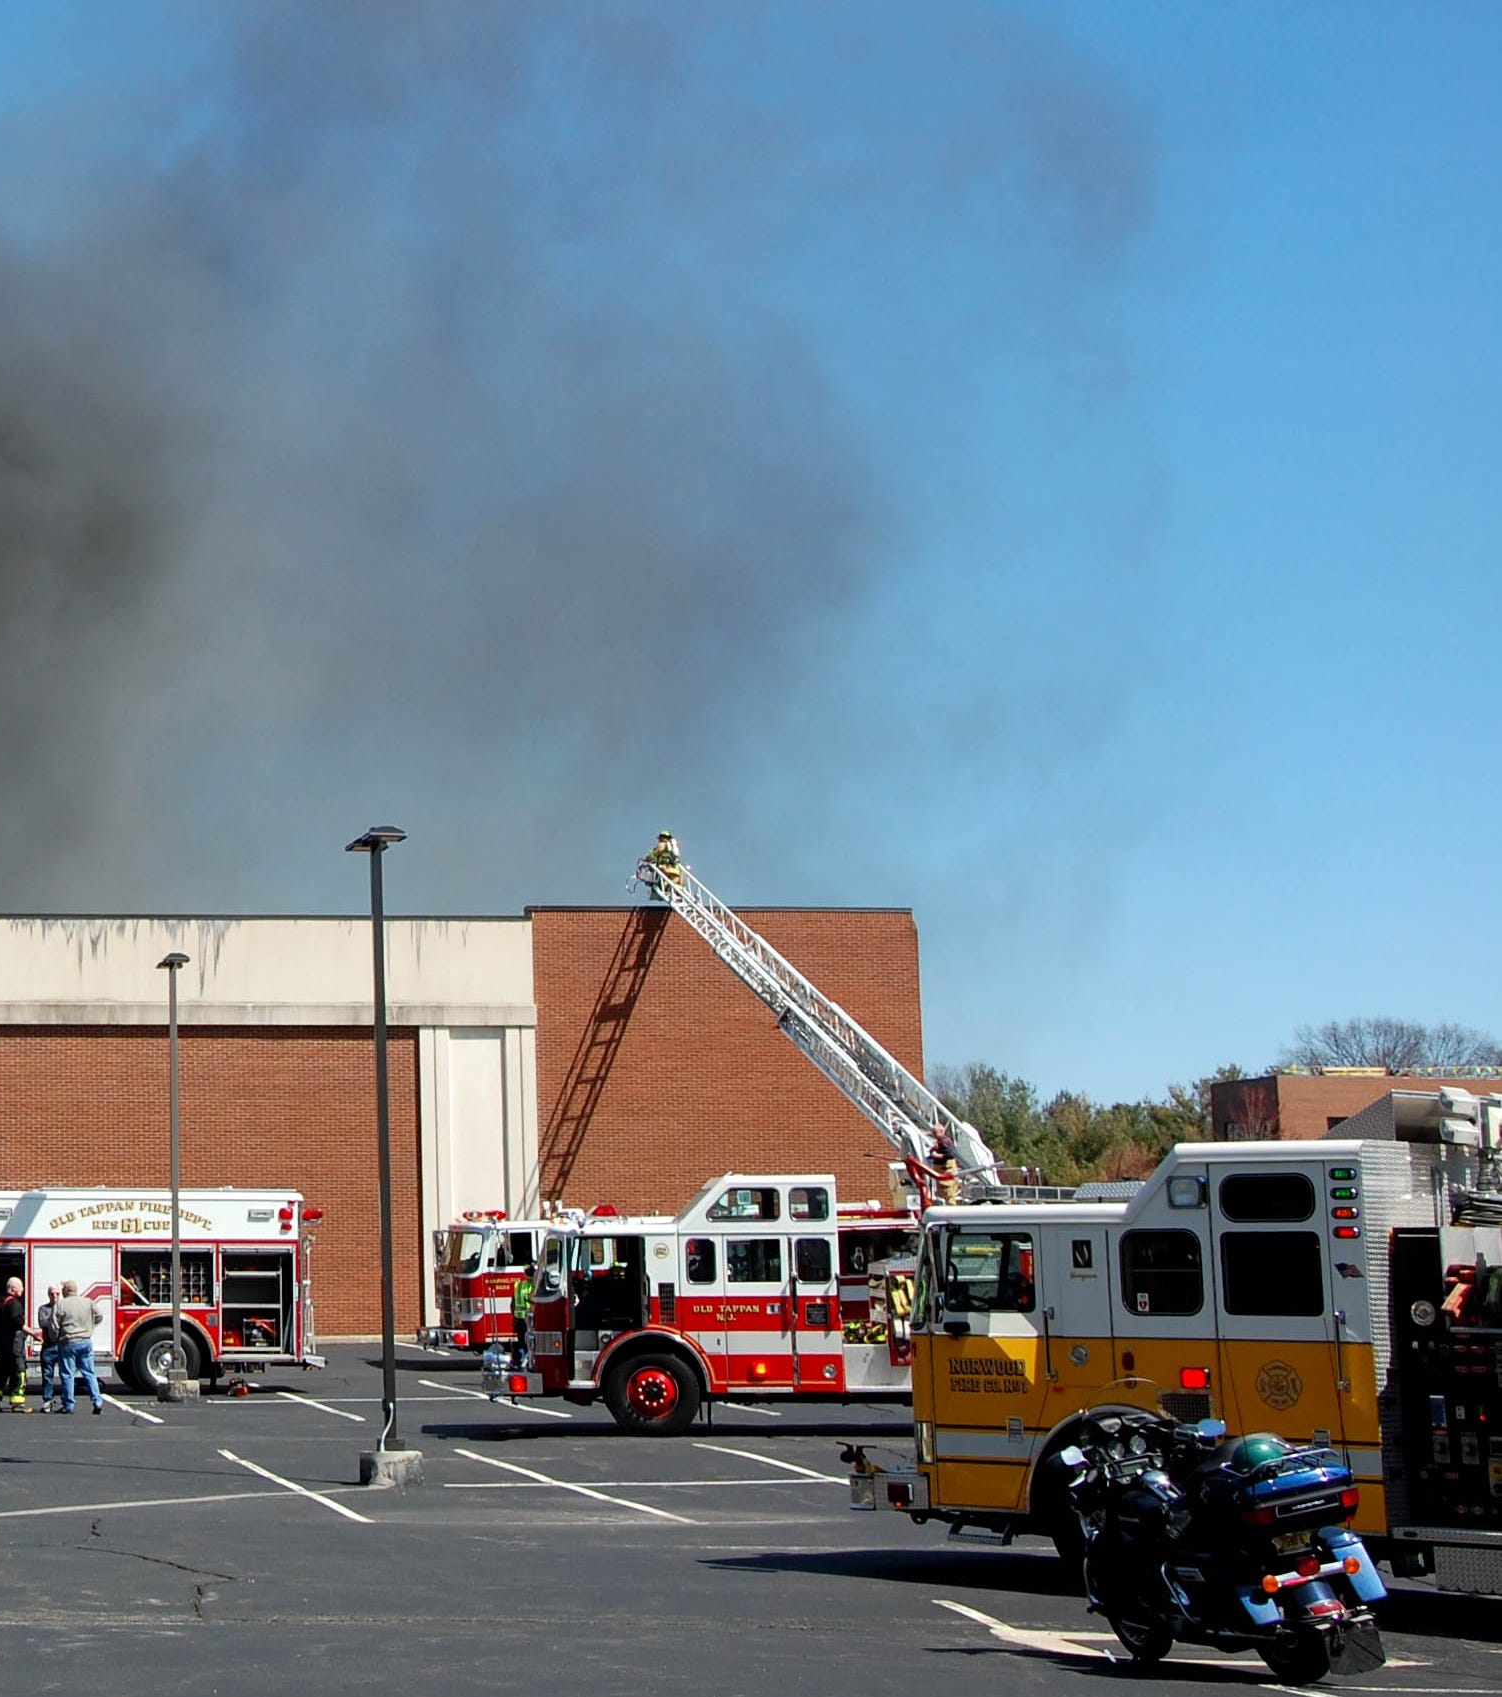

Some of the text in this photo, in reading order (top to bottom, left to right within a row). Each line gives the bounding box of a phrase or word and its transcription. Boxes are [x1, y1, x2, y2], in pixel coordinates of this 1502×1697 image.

[49, 1212, 76, 1230] OLD
[78, 1201, 135, 1218] TAPPAN
[139, 1201, 172, 1215] FIRE
[121, 1217, 142, 1234] 61
[693, 1304, 760, 1313] OLD TAPPAN
[949, 1357, 1026, 1376] NORWOOD
[950, 1378, 980, 1393] FIRE
